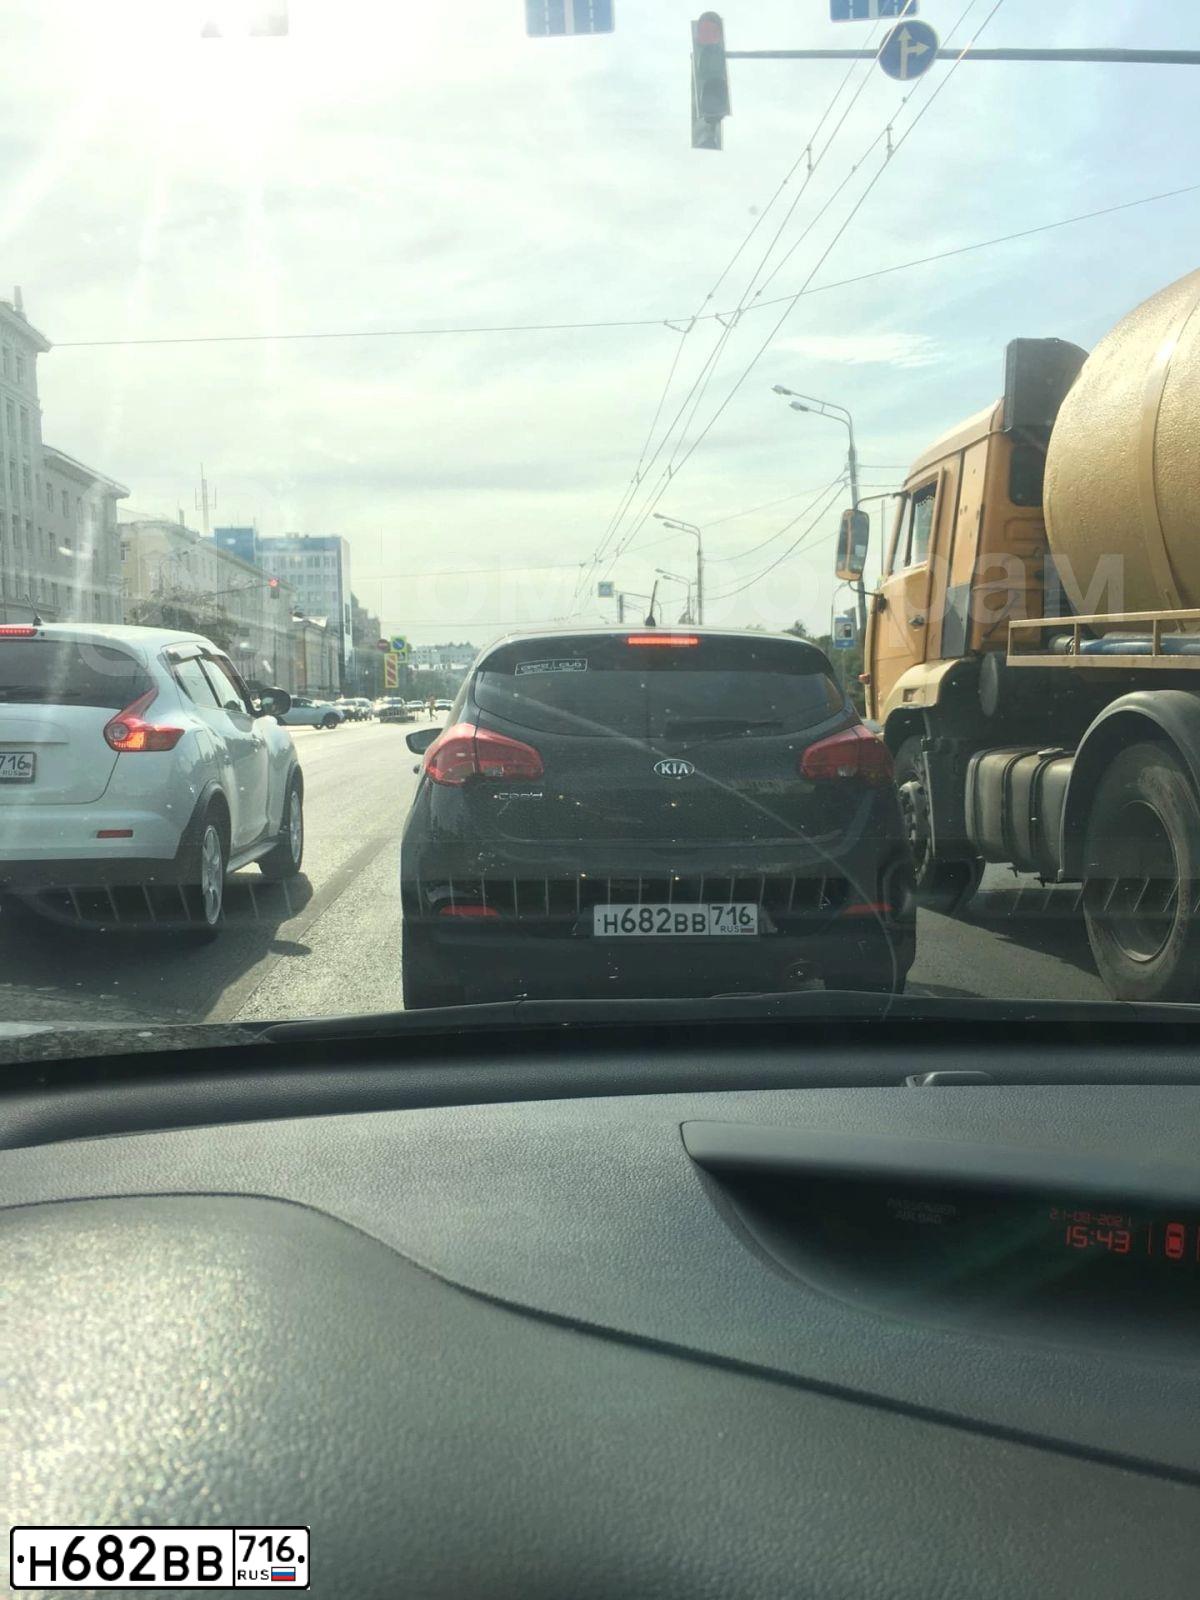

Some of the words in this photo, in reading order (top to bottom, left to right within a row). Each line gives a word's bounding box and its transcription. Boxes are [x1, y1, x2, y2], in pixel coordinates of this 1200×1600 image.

[0, 755, 26, 770] 716
[661, 762, 689, 775] KIA
[603, 907, 706, 933] Н682ВВ
[712, 906, 750, 925] 716
[720, 925, 740, 933] RUS
[1065, 1225, 1131, 1253] 15:43
